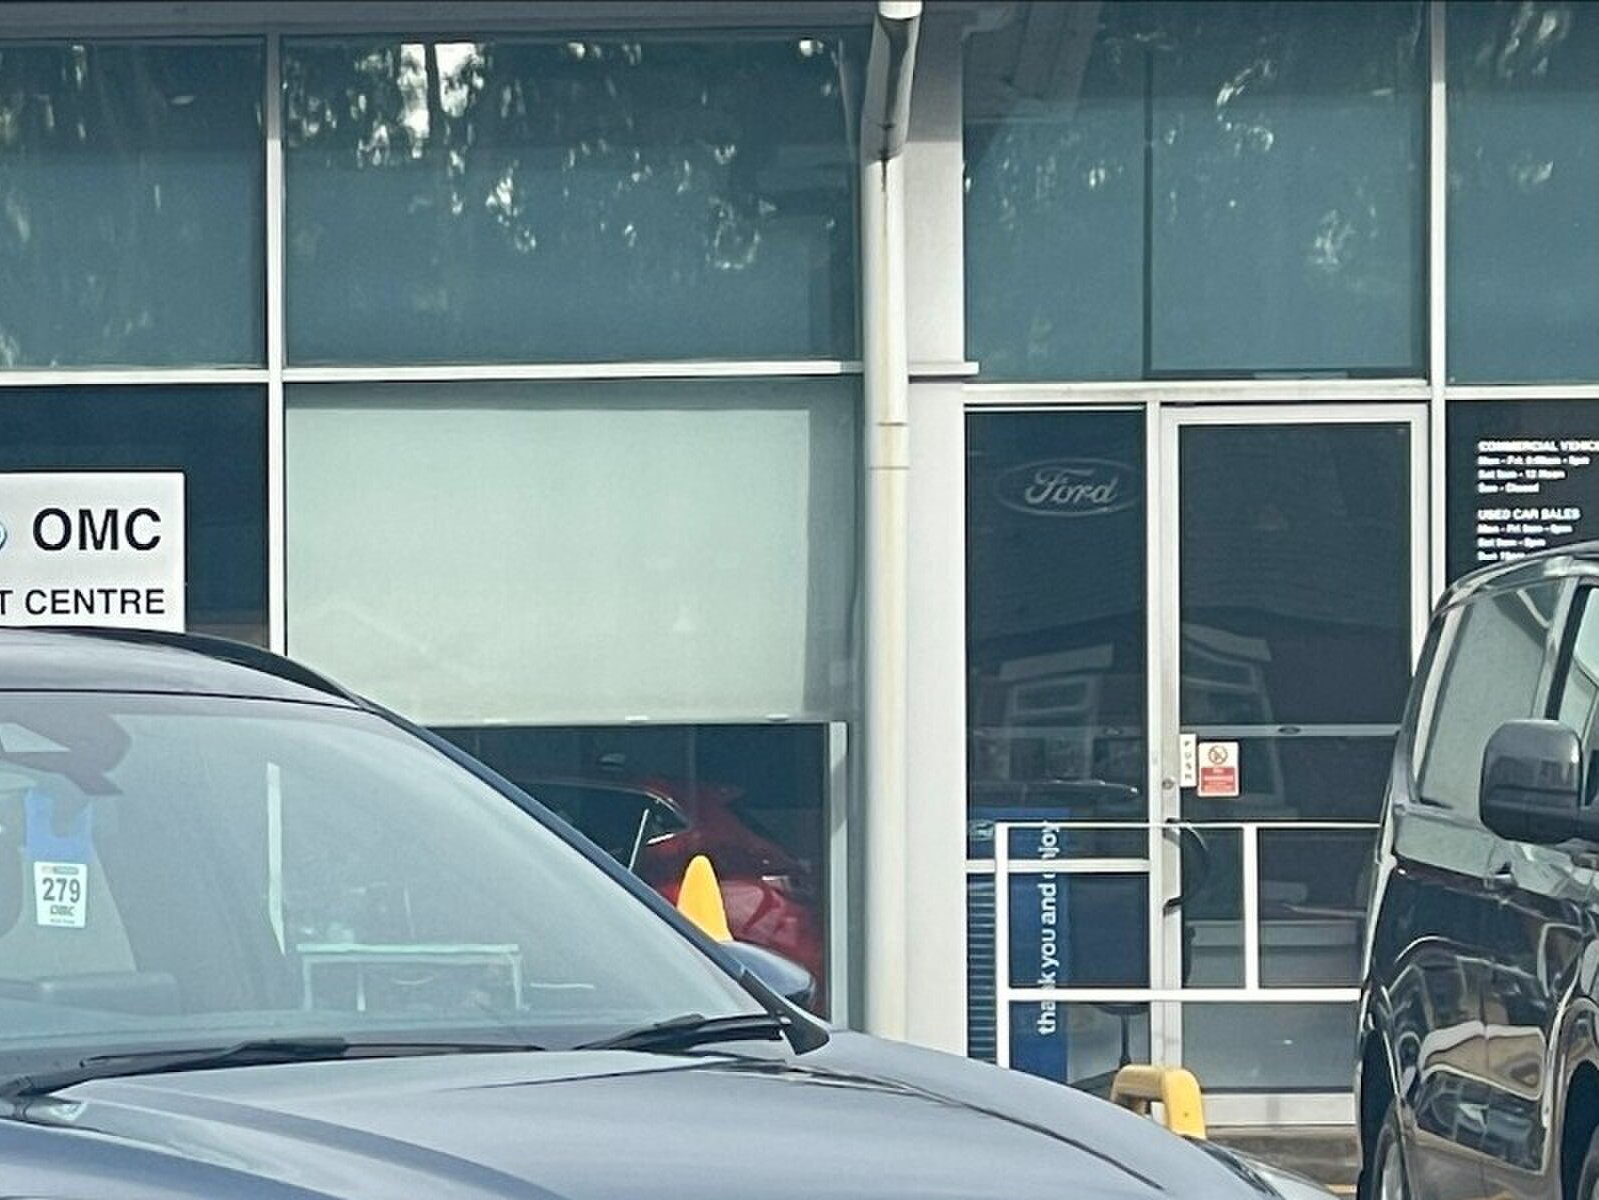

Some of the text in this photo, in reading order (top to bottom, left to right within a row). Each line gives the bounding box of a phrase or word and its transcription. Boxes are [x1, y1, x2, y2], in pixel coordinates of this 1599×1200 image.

[1025, 466, 1121, 504] Ford
[33, 507, 161, 551] OMC
[25, 588, 165, 616] CENTRE
[42, 877, 81, 904] 279
[1037, 883, 1057, 925] and
[1041, 929, 1060, 968] you
[1037, 972, 1057, 1035] thak
